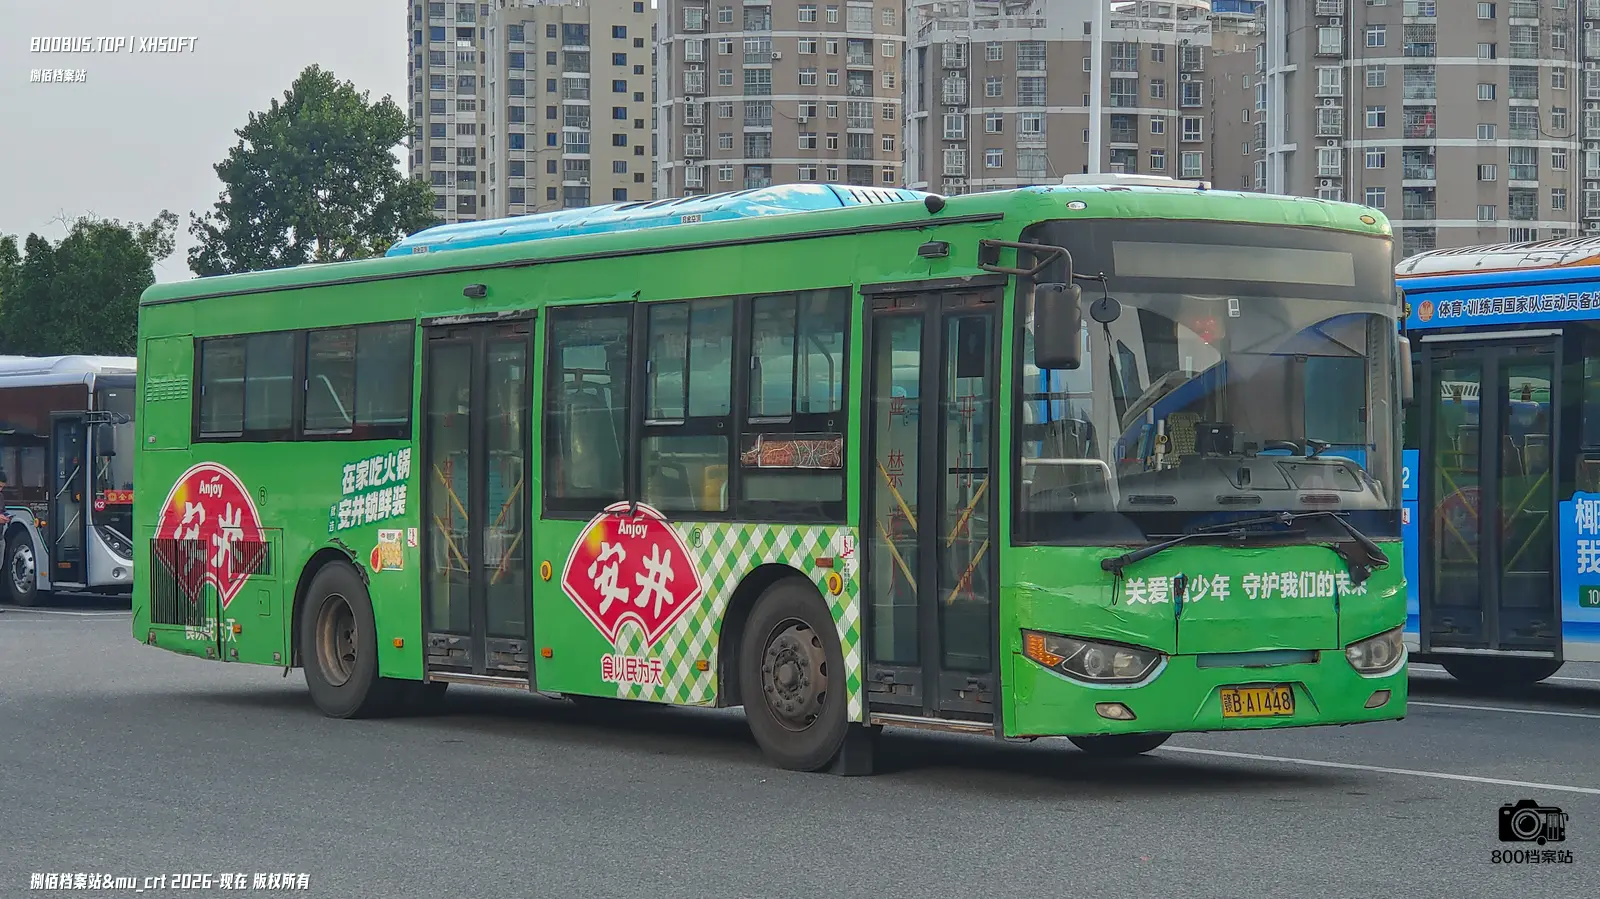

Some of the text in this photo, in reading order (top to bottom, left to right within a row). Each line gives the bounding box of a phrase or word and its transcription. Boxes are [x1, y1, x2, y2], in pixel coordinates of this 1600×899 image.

[199, 477, 223, 499] Anjoy
[342, 447, 412, 495] 在家吃火锅
[337, 484, 408, 530] 安井锁鲜装
[618, 518, 648, 539] Anjoy
[588, 542, 675, 619] 安井
[601, 654, 663, 685] 食以民为天
